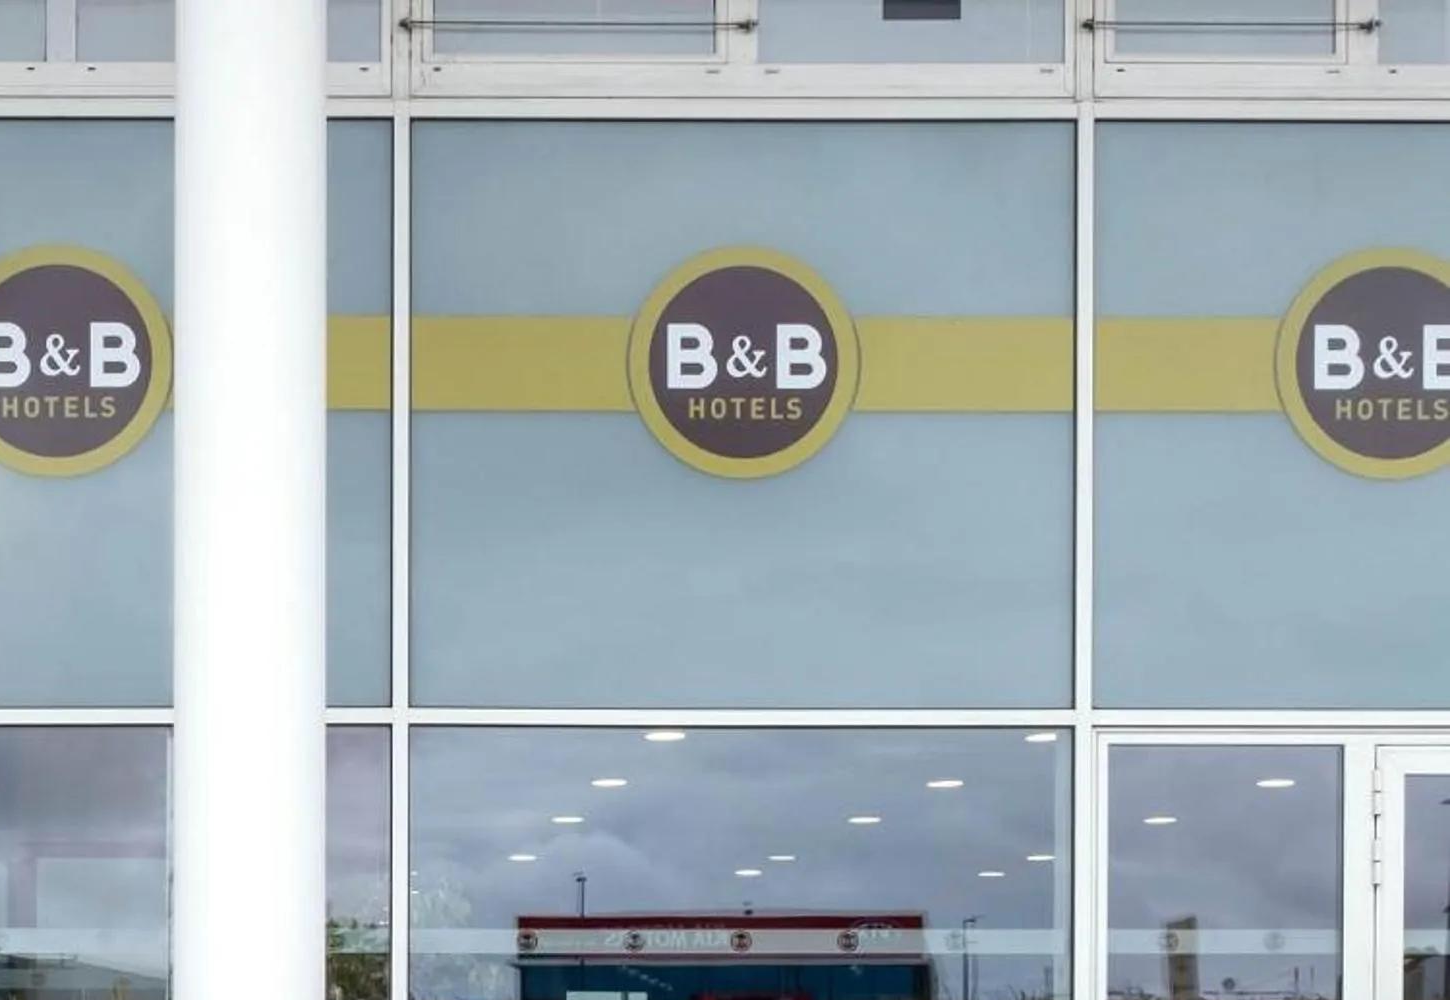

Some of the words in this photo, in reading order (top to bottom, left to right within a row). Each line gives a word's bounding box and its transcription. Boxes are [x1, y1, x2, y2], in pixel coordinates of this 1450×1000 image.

[667, 323, 827, 389] B&B
[1, 395, 118, 420] HOTELS
[687, 397, 803, 421] HOTELS
[1335, 398, 1449, 421] HOTELS
